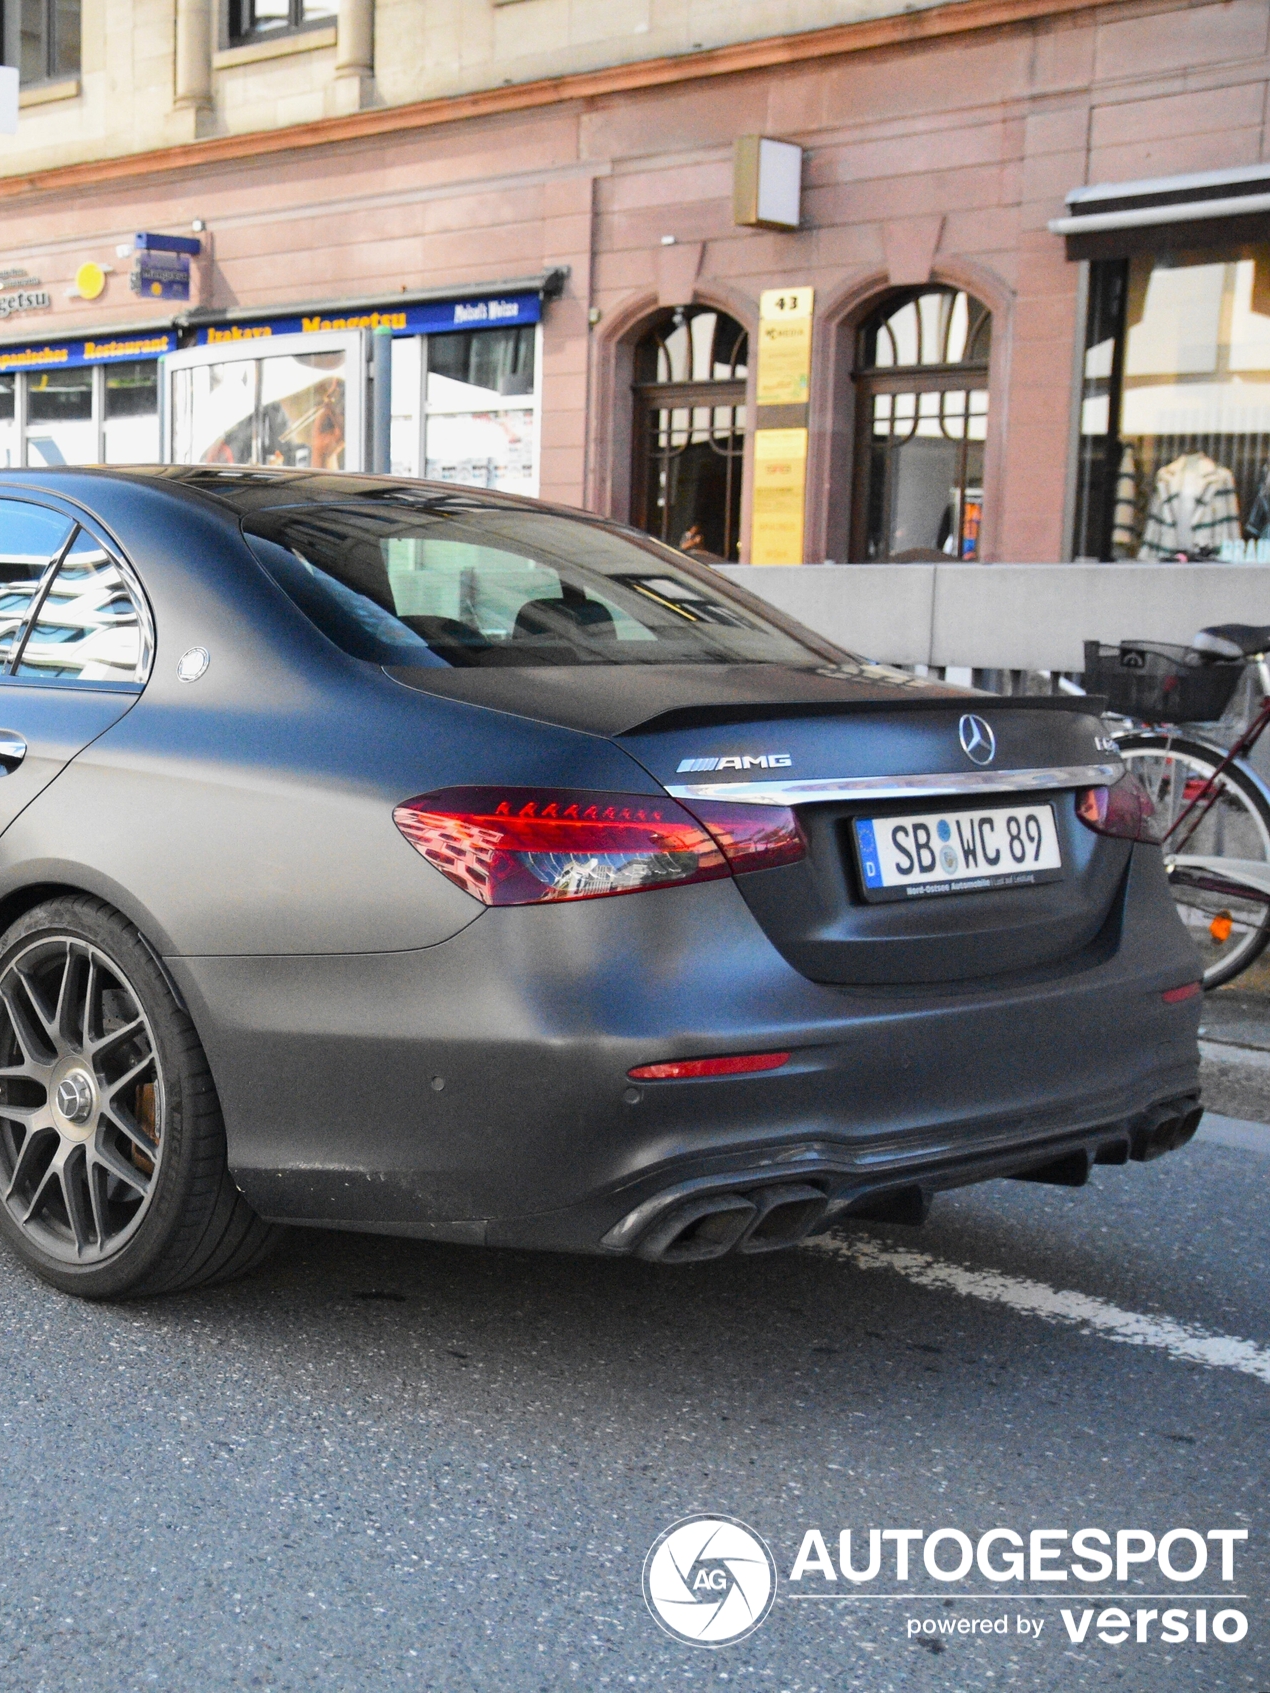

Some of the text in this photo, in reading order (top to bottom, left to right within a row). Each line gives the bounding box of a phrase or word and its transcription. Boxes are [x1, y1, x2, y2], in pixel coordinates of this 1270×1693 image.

[776, 297, 797, 311] 43
[84, 336, 169, 360] Restaurant
[714, 754, 792, 771] AMG
[891, 814, 1042, 875] SB WC 89
[866, 862, 876, 877] D
[906, 883, 949, 895] Nord-Ostsee
[951, 878, 990, 890] Automobile
